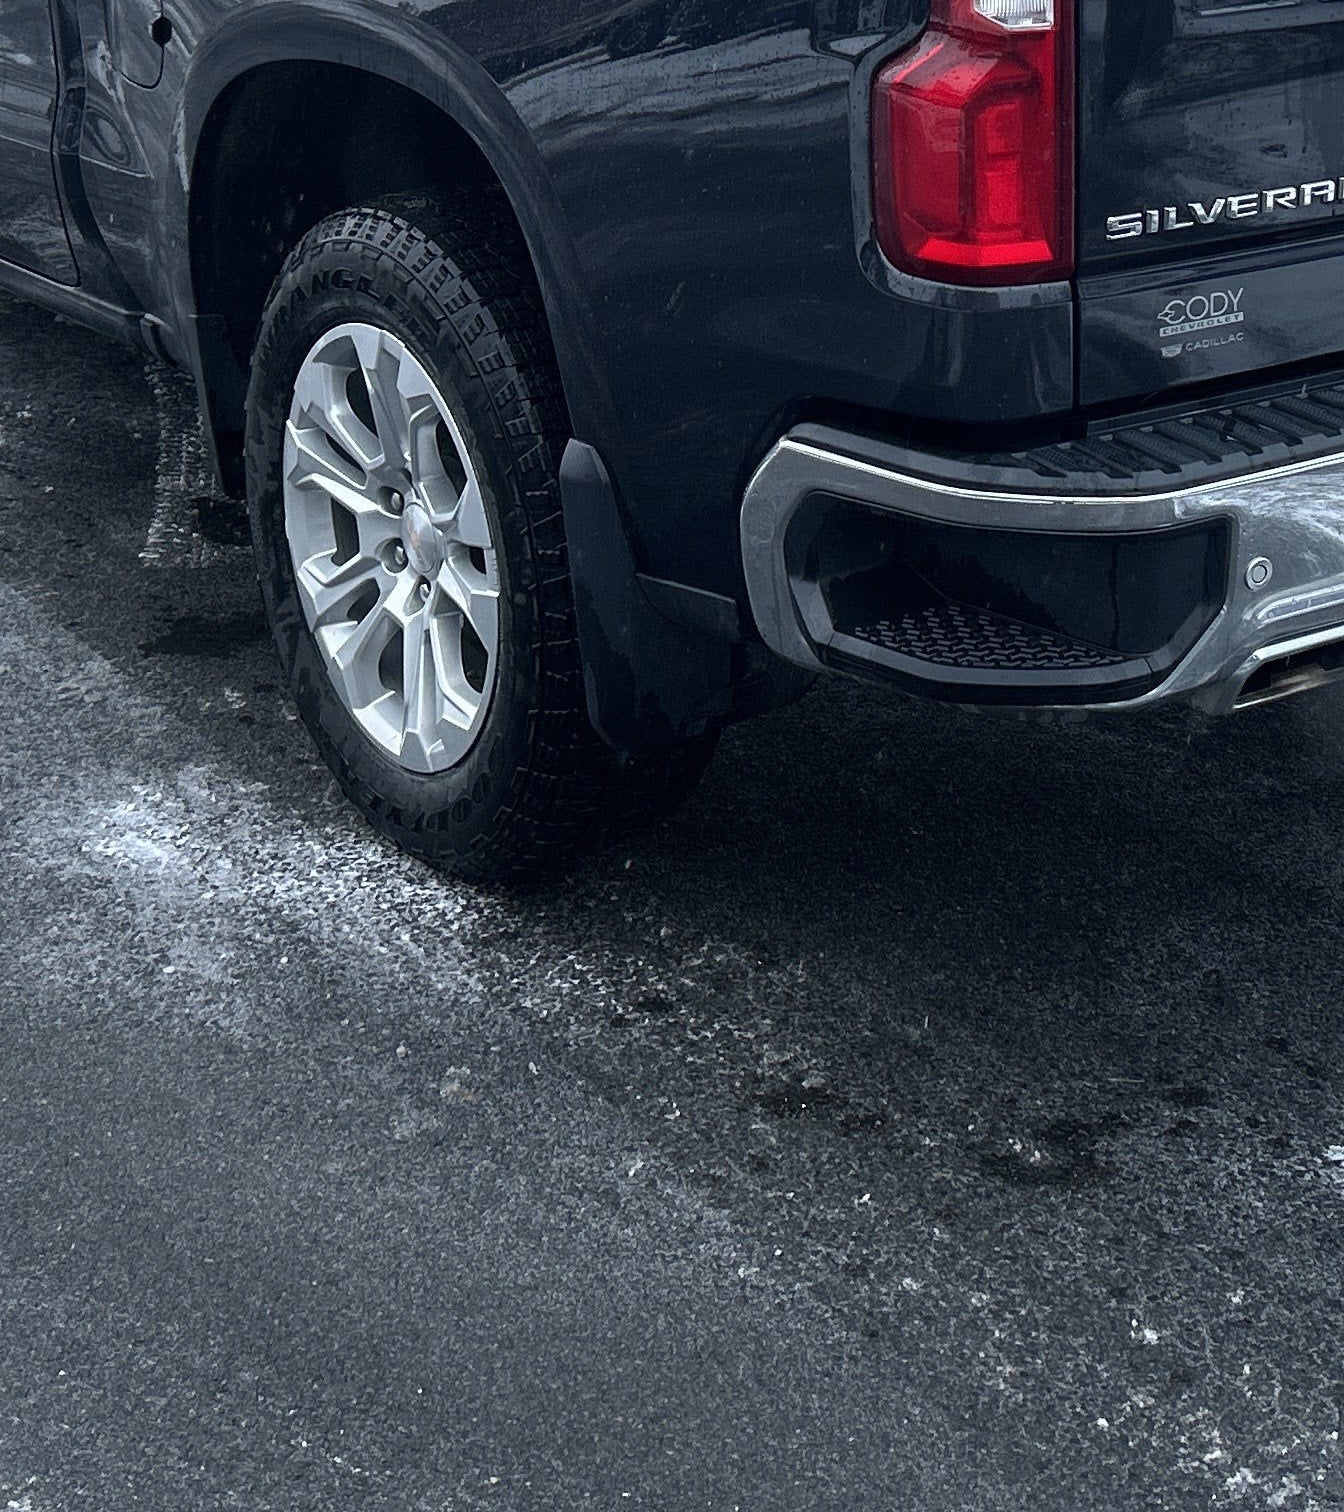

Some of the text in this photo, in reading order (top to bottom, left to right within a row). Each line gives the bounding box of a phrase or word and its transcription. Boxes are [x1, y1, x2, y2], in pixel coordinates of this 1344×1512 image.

[1157, 287, 1244, 324] CODY
[1162, 314, 1241, 335] CHEVROLET
[1186, 332, 1244, 351] CADILLAC
